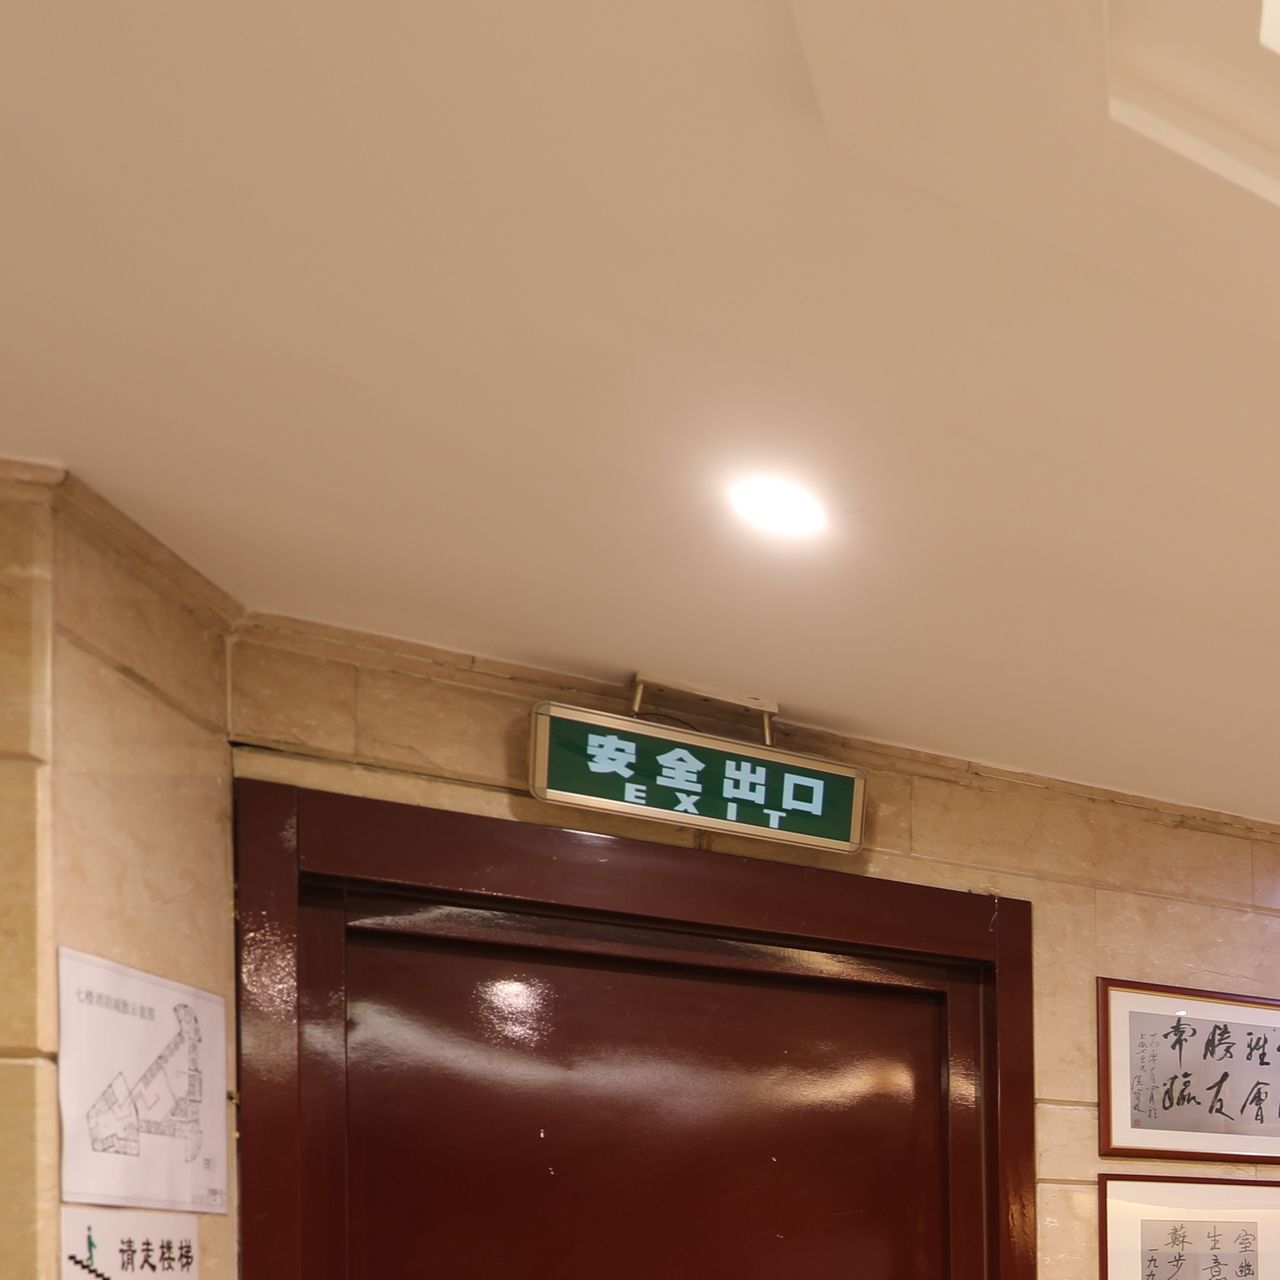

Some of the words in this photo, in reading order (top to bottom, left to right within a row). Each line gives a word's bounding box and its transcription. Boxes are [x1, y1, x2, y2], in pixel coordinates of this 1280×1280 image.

[586, 733, 825, 816] 安全出口
[624, 782, 786, 829] EXIT
[118, 1237, 195, 1273] 请走楼梯
